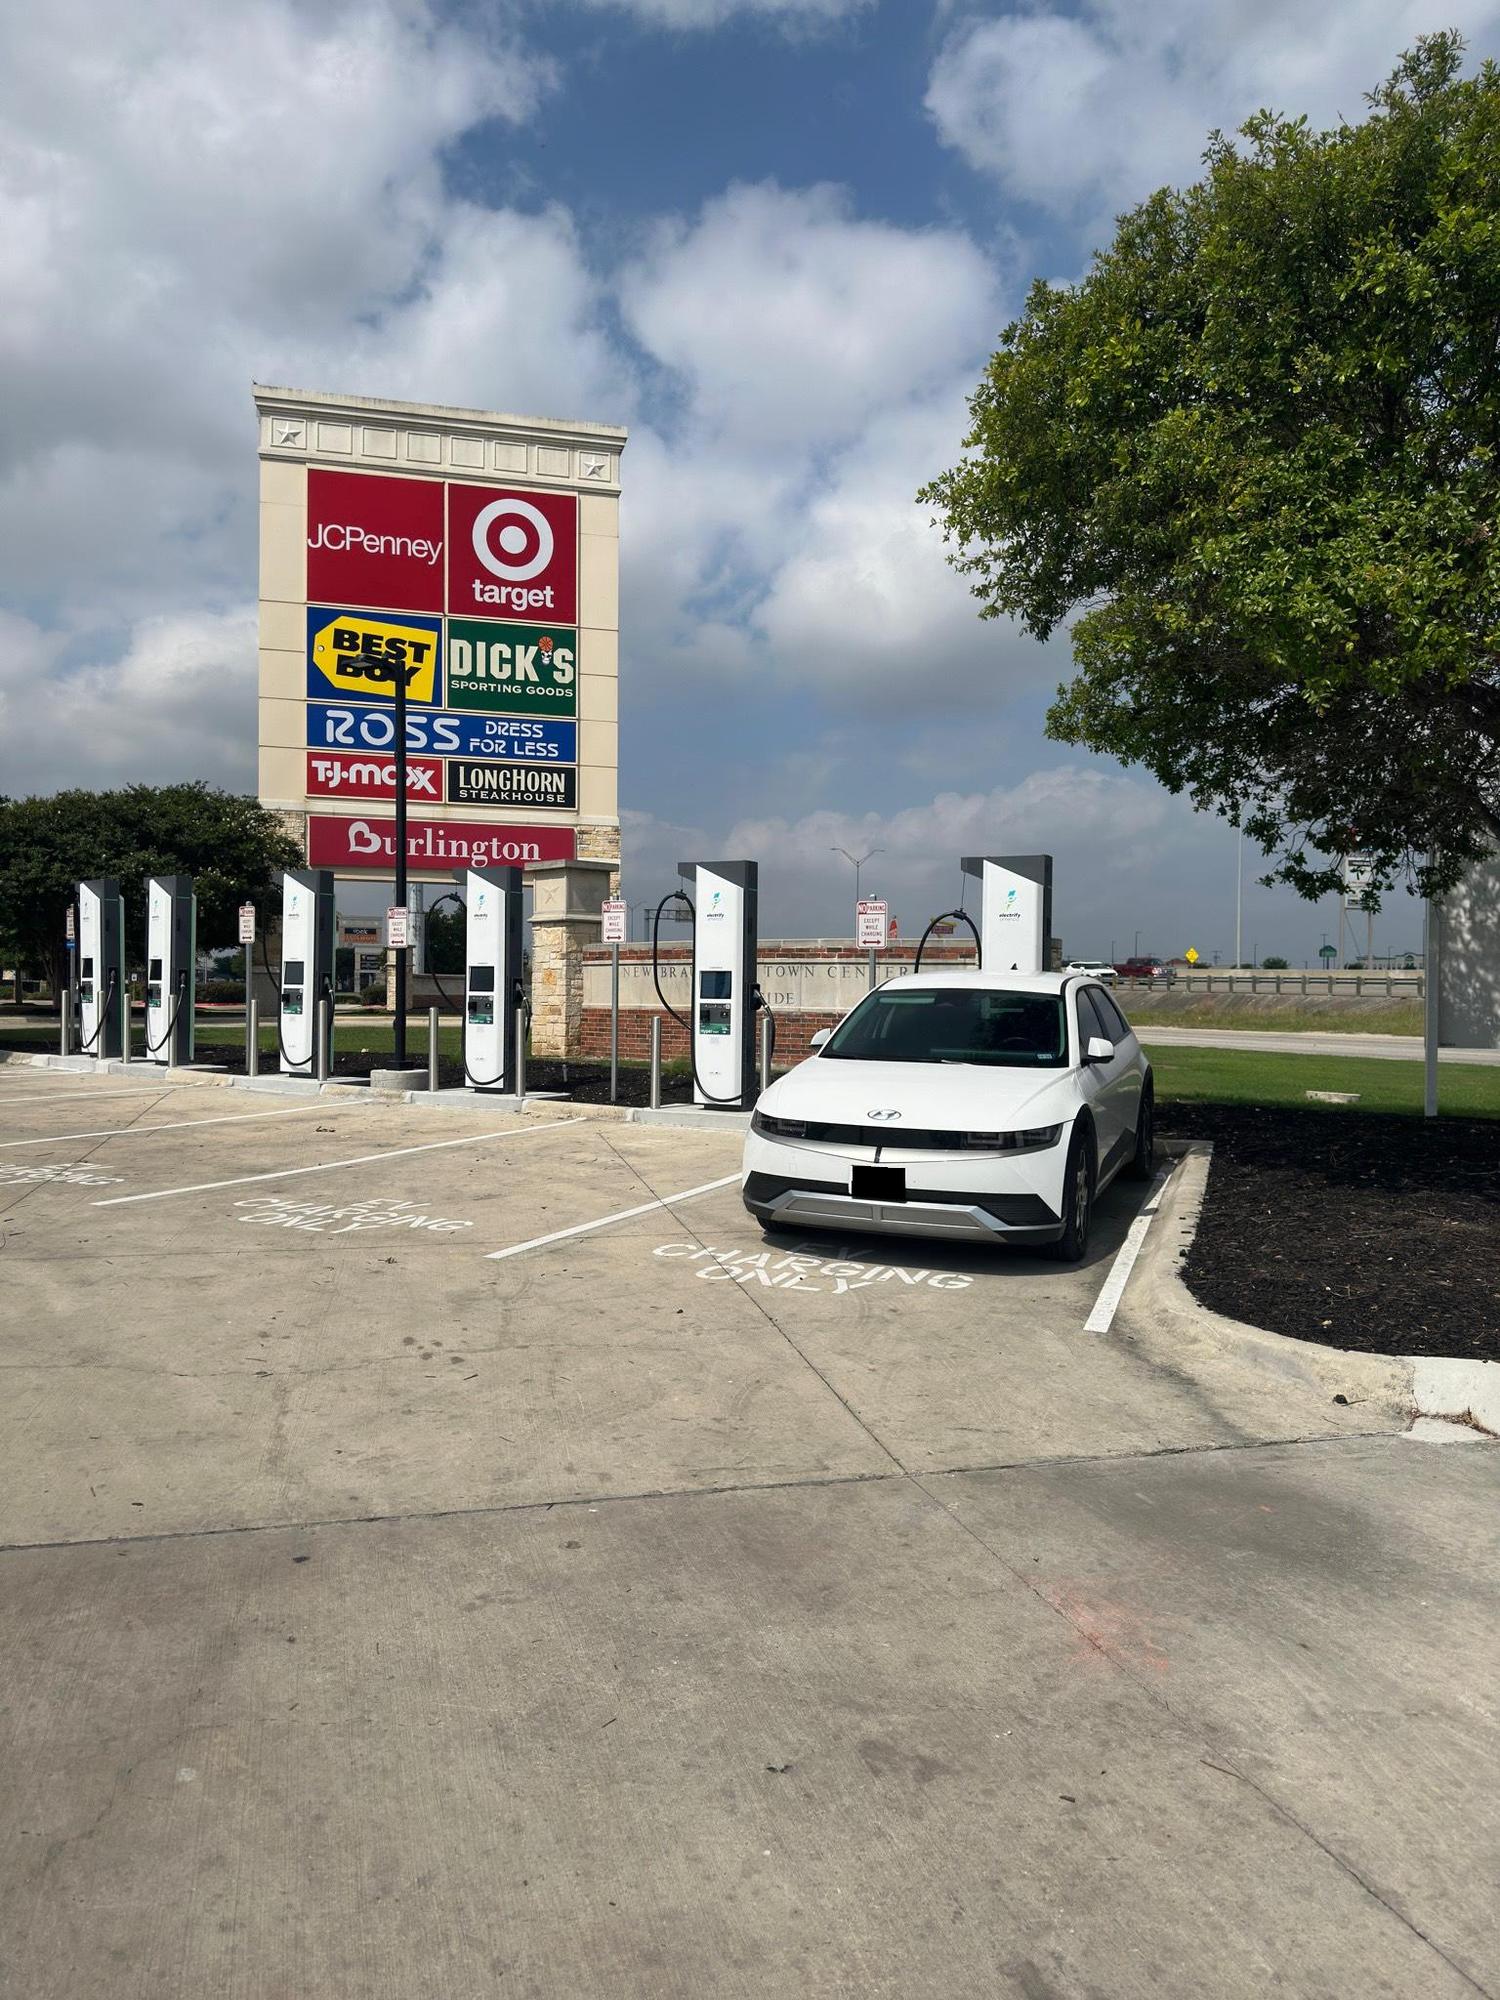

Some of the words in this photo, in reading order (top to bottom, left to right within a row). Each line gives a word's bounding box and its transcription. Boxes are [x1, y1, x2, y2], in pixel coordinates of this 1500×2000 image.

[307, 523, 443, 565] JCPenney
[472, 579, 554, 611] target
[333, 628, 431, 663] BEST
[450, 637, 574, 684] DICK'S
[451, 680, 522, 694] SPORTING
[526, 686, 574, 697] GOODS
[326, 709, 460, 751] ROSS
[485, 721, 544, 738] DRESS
[469, 738, 506, 754] FOR
[514, 741, 559, 757] LESS
[459, 766, 565, 793] LONGHORN
[459, 789, 565, 803] STEAKHOUSE
[348, 821, 542, 868] Burlington
[623, 966, 652, 978] NEW
[660, 966, 694, 978] BRA
[764, 965, 815, 978] TOWN
[652, 1243, 975, 1290] CHARGING
[695, 1264, 874, 1294] ONLY
